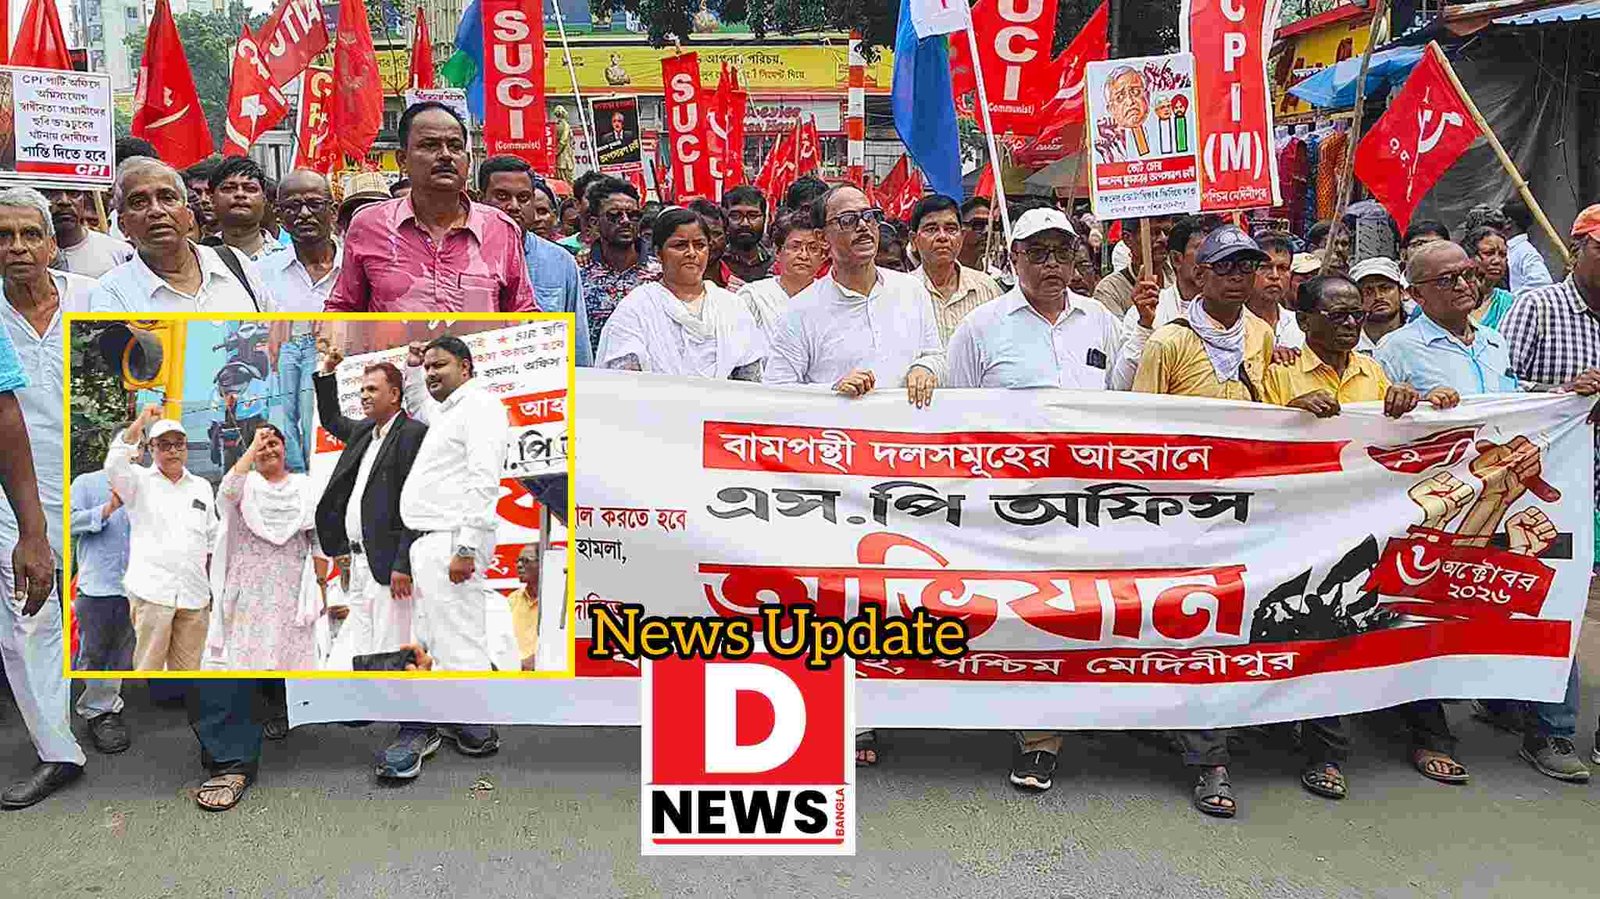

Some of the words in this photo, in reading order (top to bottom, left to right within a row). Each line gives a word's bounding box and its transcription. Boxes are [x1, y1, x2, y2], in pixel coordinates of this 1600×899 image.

[22, 75, 42, 85] CPI
[53, 144, 81, 160] দিতে
[84, 150, 106, 162] হবে
[74, 164, 106, 176] CPI
[1203, 131, 1264, 183] (M)
[719, 431, 856, 476] বামপন্থী
[868, 440, 1054, 479] দলসমূহের
[1068, 440, 1212, 475] আহ্বানে
[600, 507, 650, 529] করতে
[655, 509, 687, 531] হবে
[706, 481, 967, 528] এস.পি
[990, 483, 1255, 530] অফিস
[1396, 545, 1442, 586] ৬
[1441, 558, 1539, 593] অক্টোবর
[698, 531, 1248, 646] অভিযান
[932, 652, 1068, 677] পশ্চিম
[1085, 648, 1300, 677] মেদিনীপুর
